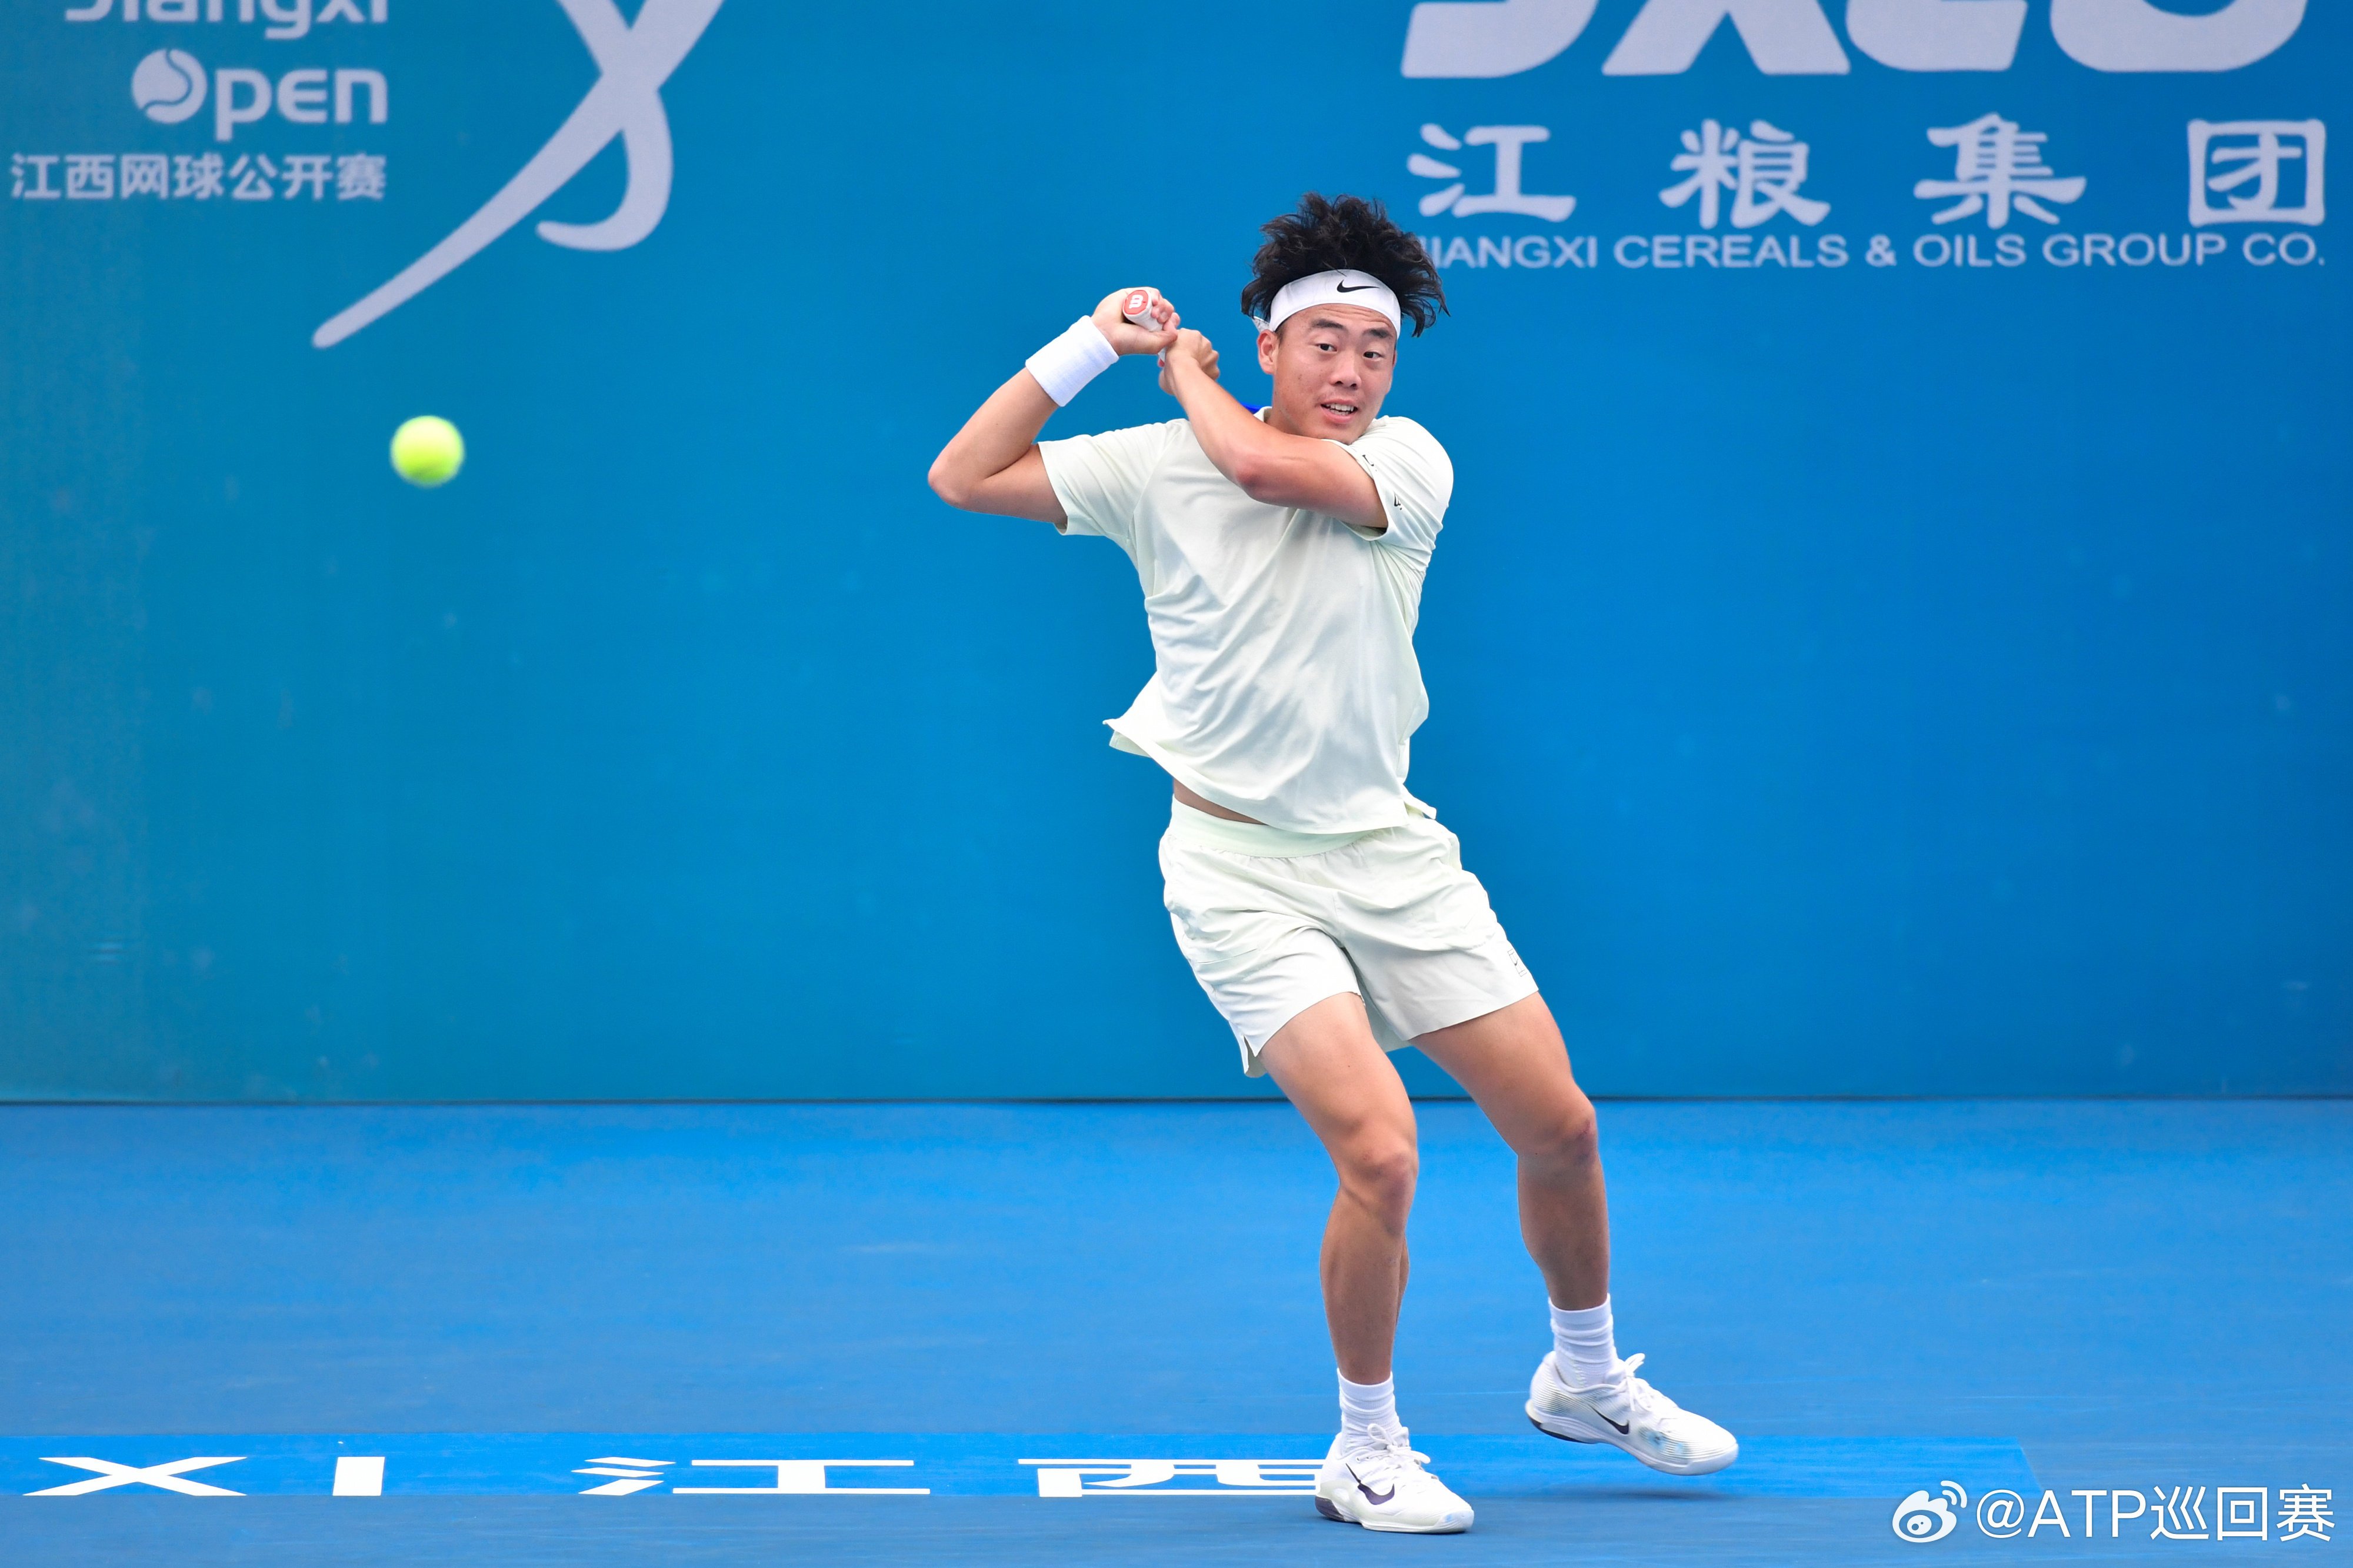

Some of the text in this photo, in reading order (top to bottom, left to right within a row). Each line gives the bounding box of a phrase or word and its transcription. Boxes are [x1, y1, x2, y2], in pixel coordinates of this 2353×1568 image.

[11, 152, 386, 200] 江西网球公开赛
[1408, 114, 2327, 229] 江粮集团
[1419, 233, 2325, 269] IANGXI CEREALS & OILS GROUP CO.
